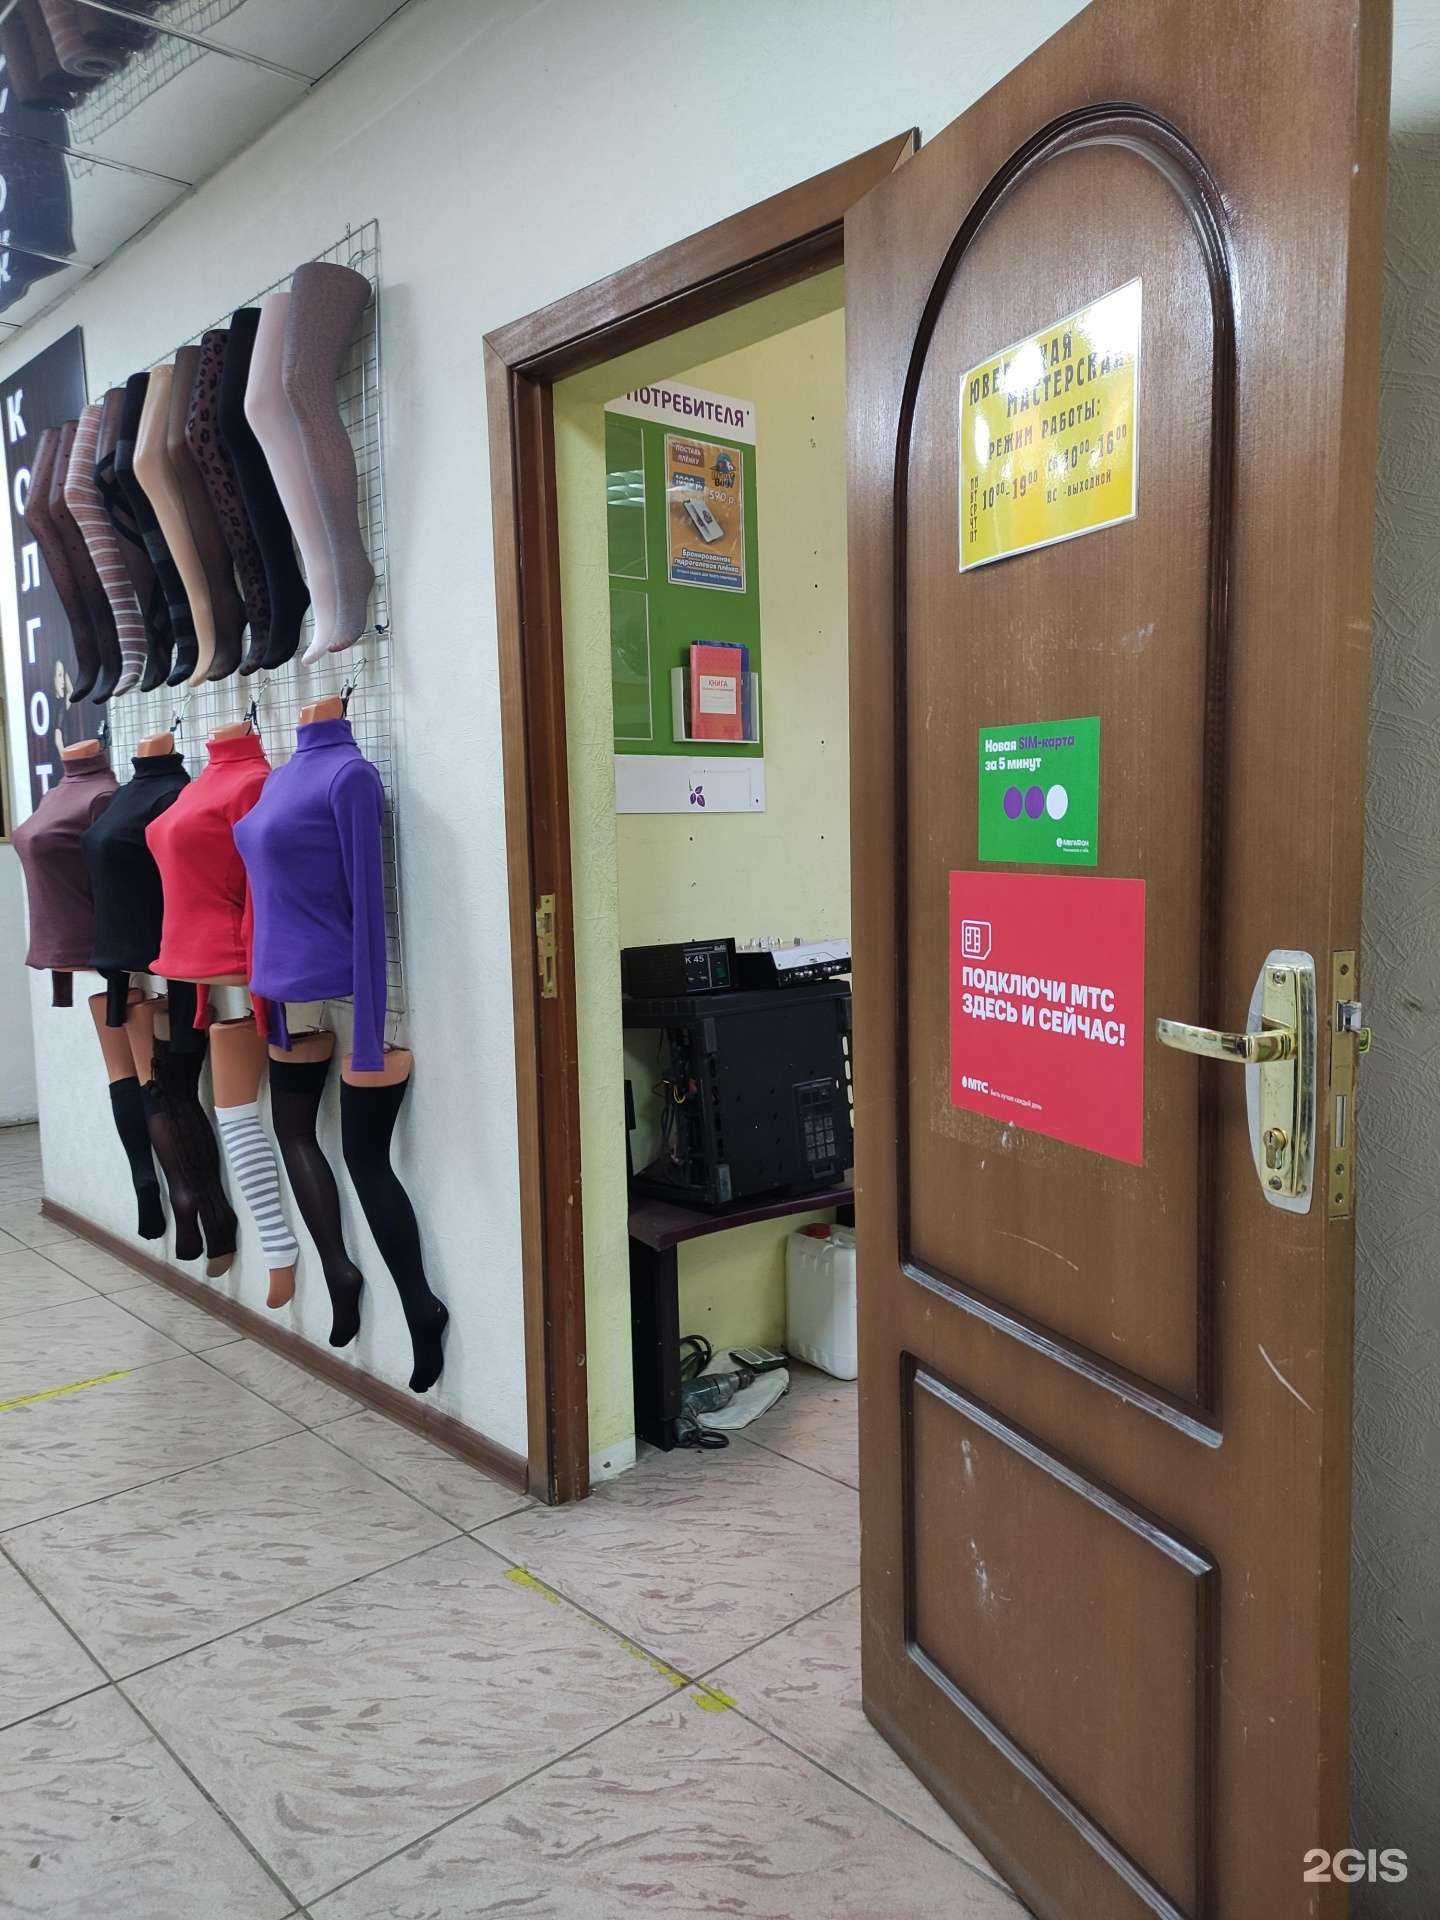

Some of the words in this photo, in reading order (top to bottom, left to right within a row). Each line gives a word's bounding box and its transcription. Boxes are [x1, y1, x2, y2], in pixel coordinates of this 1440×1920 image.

[969, 331, 1072, 406] ЮВЕНАЯ
[988, 425, 1033, 460] РЕЖИМ
[1041, 398, 1101, 439] РАБОТЫ:
[708, 679, 728, 689] КНИГА
[984, 739, 1017, 753] Новая
[1018, 735, 1076, 751] SIM-карта
[984, 759, 997, 771] за
[998, 756, 1006, 770] 5
[1007, 757, 1042, 772] минут
[693, 954, 705, 963] 45
[961, 966, 1066, 1004] ПОДКЛЮЧИ
[1071, 982, 1116, 1013] МТС
[961, 993, 1019, 1023] ЗДЕСЬ
[1021, 1004, 1035, 1027] И
[1038, 1006, 1126, 1047] СЕЙЧАС!
[967, 1077, 989, 1095] МТС
